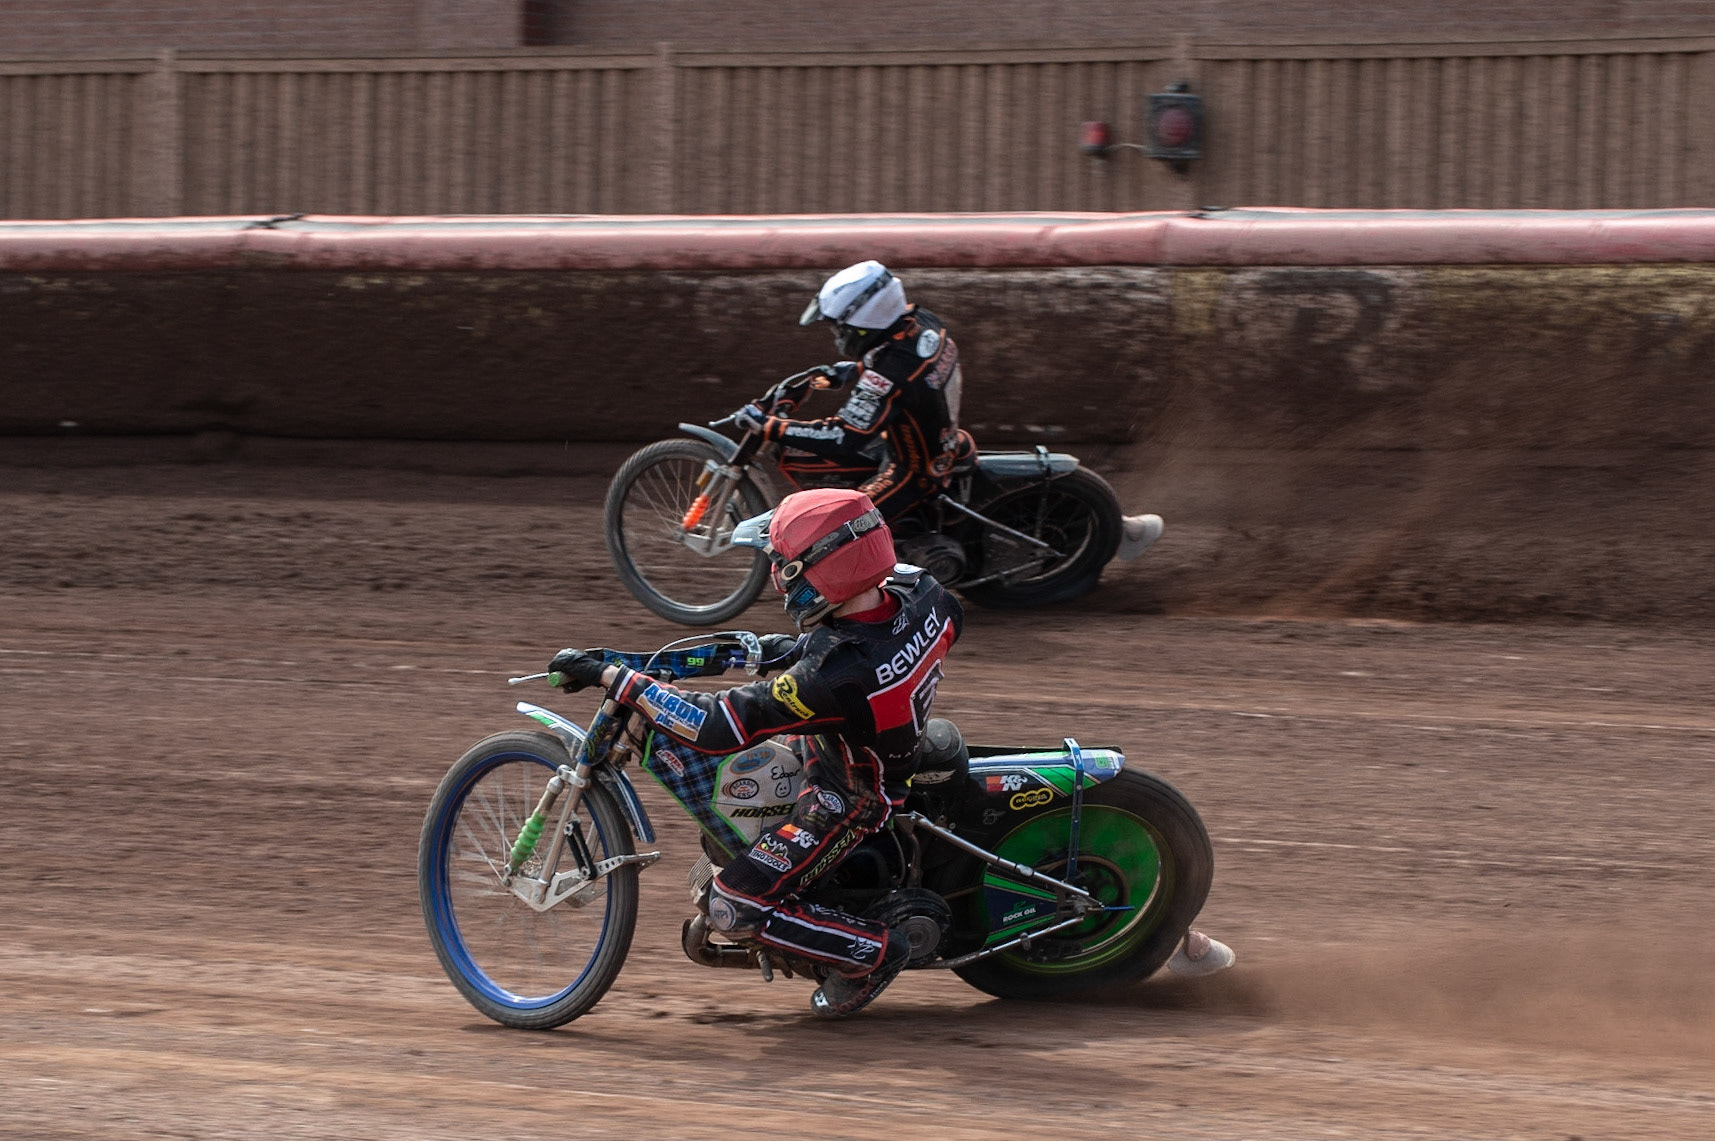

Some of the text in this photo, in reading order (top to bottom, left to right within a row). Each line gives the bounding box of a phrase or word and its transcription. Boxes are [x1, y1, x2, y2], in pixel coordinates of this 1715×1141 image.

[875, 606, 940, 685] BEWLEY
[686, 656, 705, 667] 99
[644, 683, 705, 727] ALBON
[771, 765, 801, 782] Edgar
[1002, 907, 1037, 923] ROCK OIL
